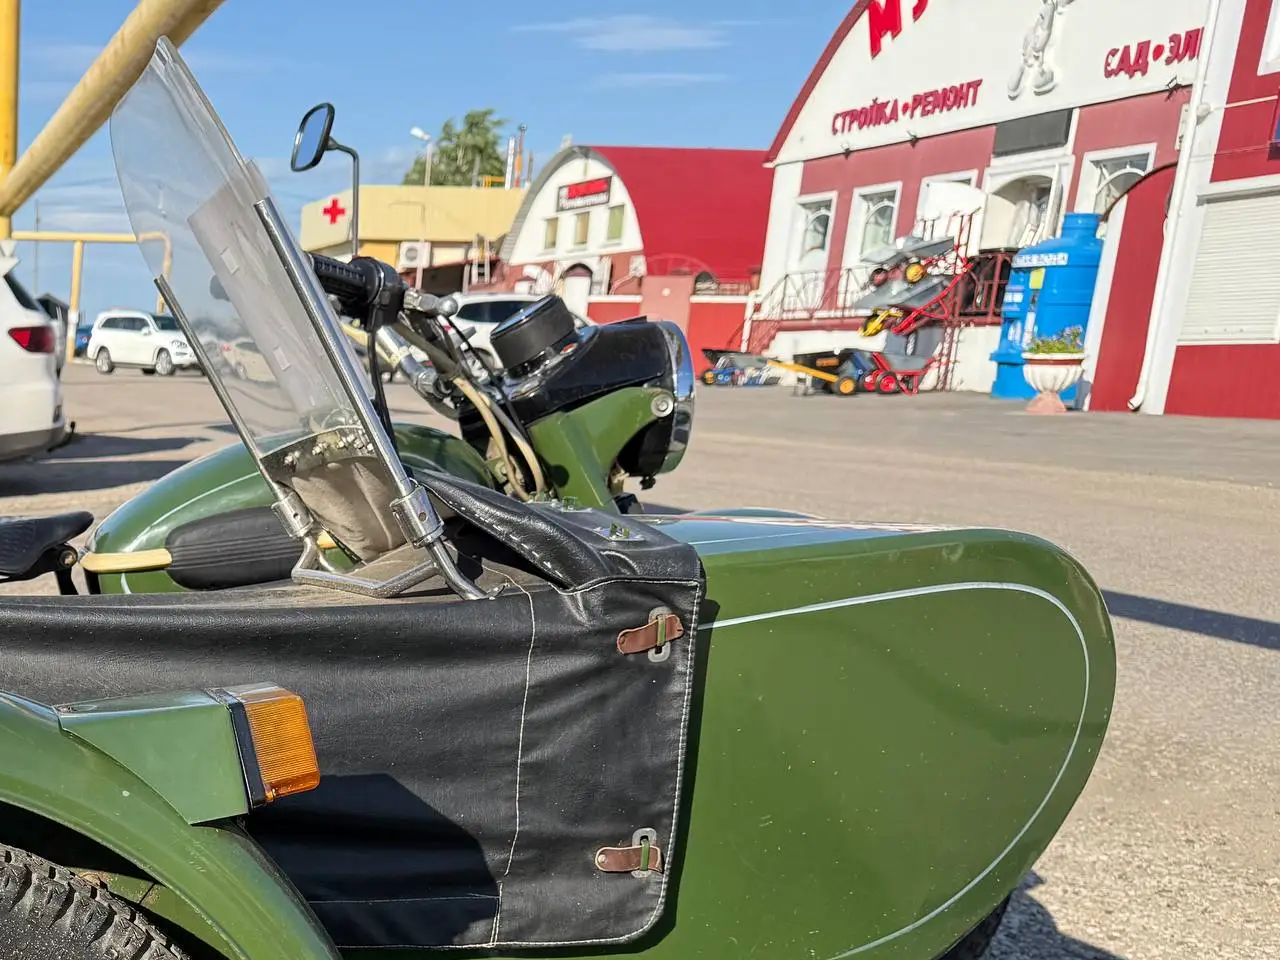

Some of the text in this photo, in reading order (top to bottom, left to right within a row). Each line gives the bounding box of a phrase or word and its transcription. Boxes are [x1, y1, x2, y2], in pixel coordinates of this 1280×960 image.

[1104, 26, 1205, 80] САД ЭЛ
[832, 79, 983, 136] СТРОЙКА РЕМОНТ
